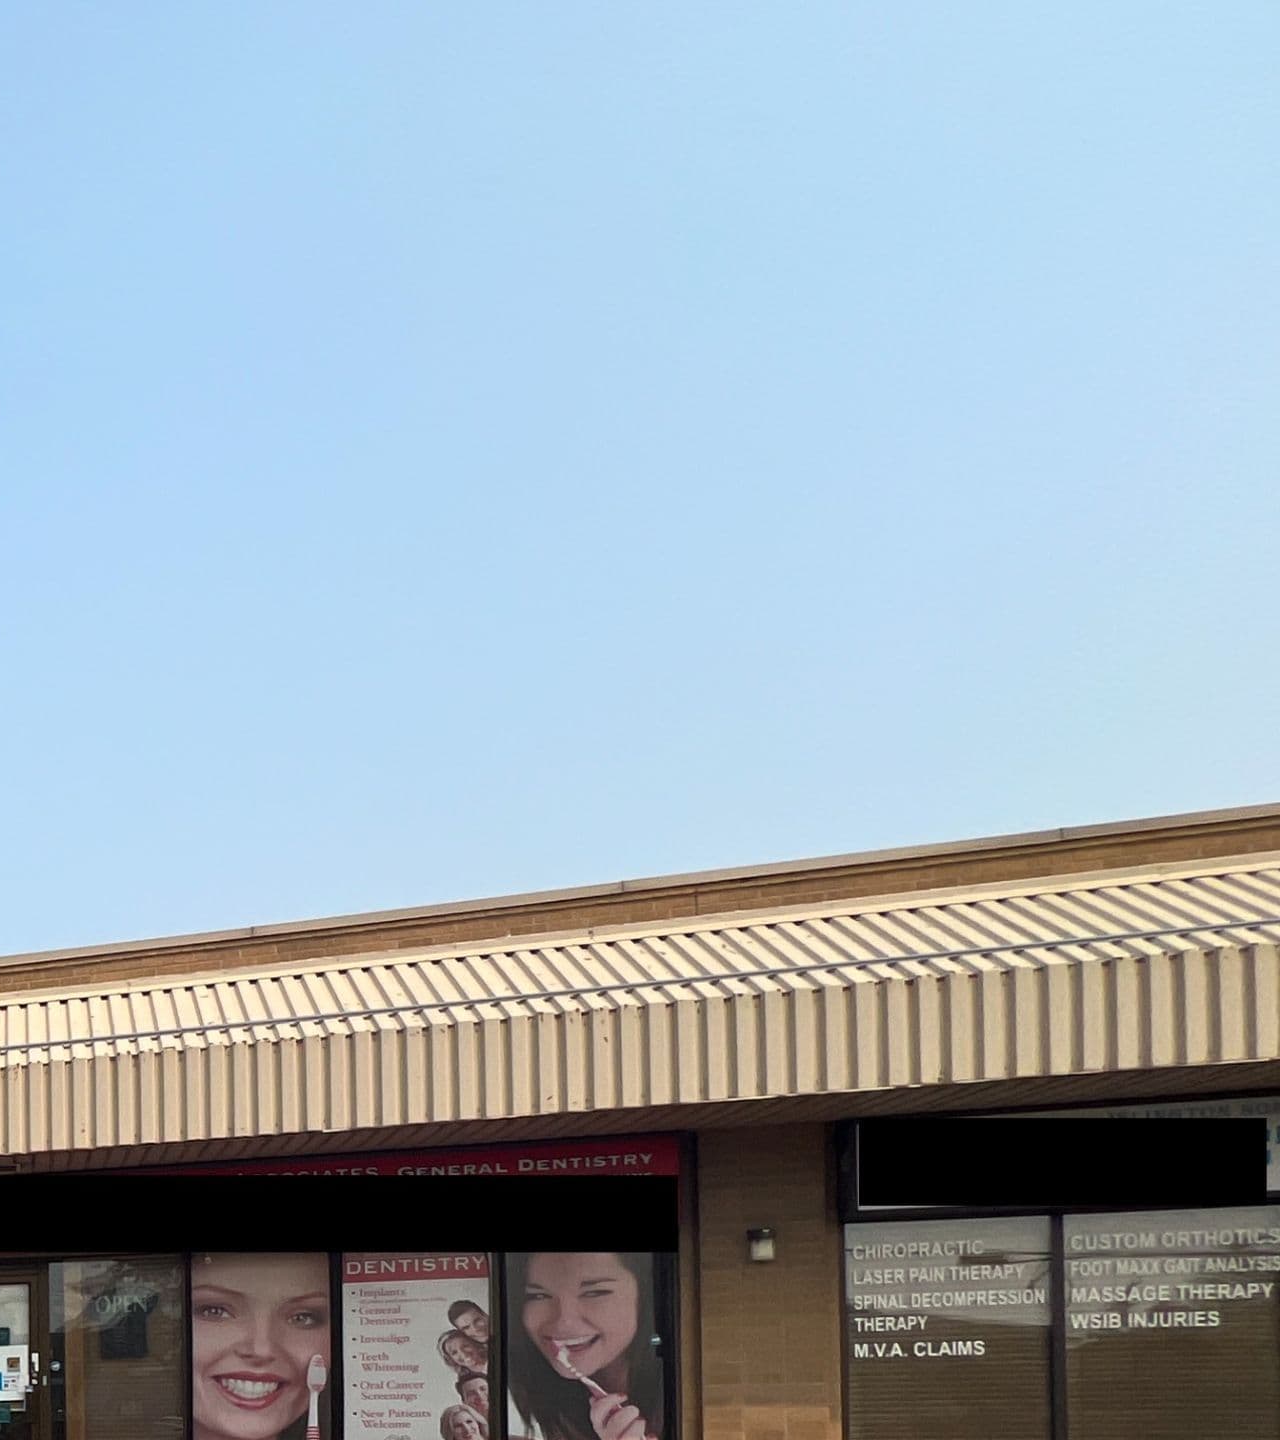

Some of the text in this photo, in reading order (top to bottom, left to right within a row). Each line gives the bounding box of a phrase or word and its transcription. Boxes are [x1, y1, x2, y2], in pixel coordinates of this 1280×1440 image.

[397, 1162, 508, 1176] GENERAL
[518, 1153, 653, 1172] DENTISTRY
[1070, 1227, 1280, 1250] CUSTOM ORTHOTICS
[852, 1240, 984, 1260] CHIROPRACTIC
[345, 1255, 486, 1275] DENTISTRY
[1070, 1260, 1111, 1276] FOOT
[1204, 1255, 1280, 1273] ANALYSIS
[853, 1264, 1025, 1285] LASER PAIN THERAPY
[853, 1288, 1046, 1311] SPINAL DECOMPRESSION
[1070, 1282, 1274, 1303] MASSAGE THERAPY
[94, 1295, 148, 1313] OPEN
[358, 1305, 401, 1315] General
[359, 1317, 411, 1327] Dentistry
[853, 1315, 928, 1332] THERAPY
[1070, 1310, 1221, 1329] WSIB INJURIES
[359, 1352, 389, 1362] Teeth
[853, 1340, 985, 1358] M.V.A. CLAIMS
[361, 1363, 420, 1374] Whitening
[359, 1380, 425, 1390] Oral Cancer
[360, 1392, 418, 1402] Screenings
[360, 1409, 432, 1418] New Patients
[361, 1420, 412, 1429] Welcome
